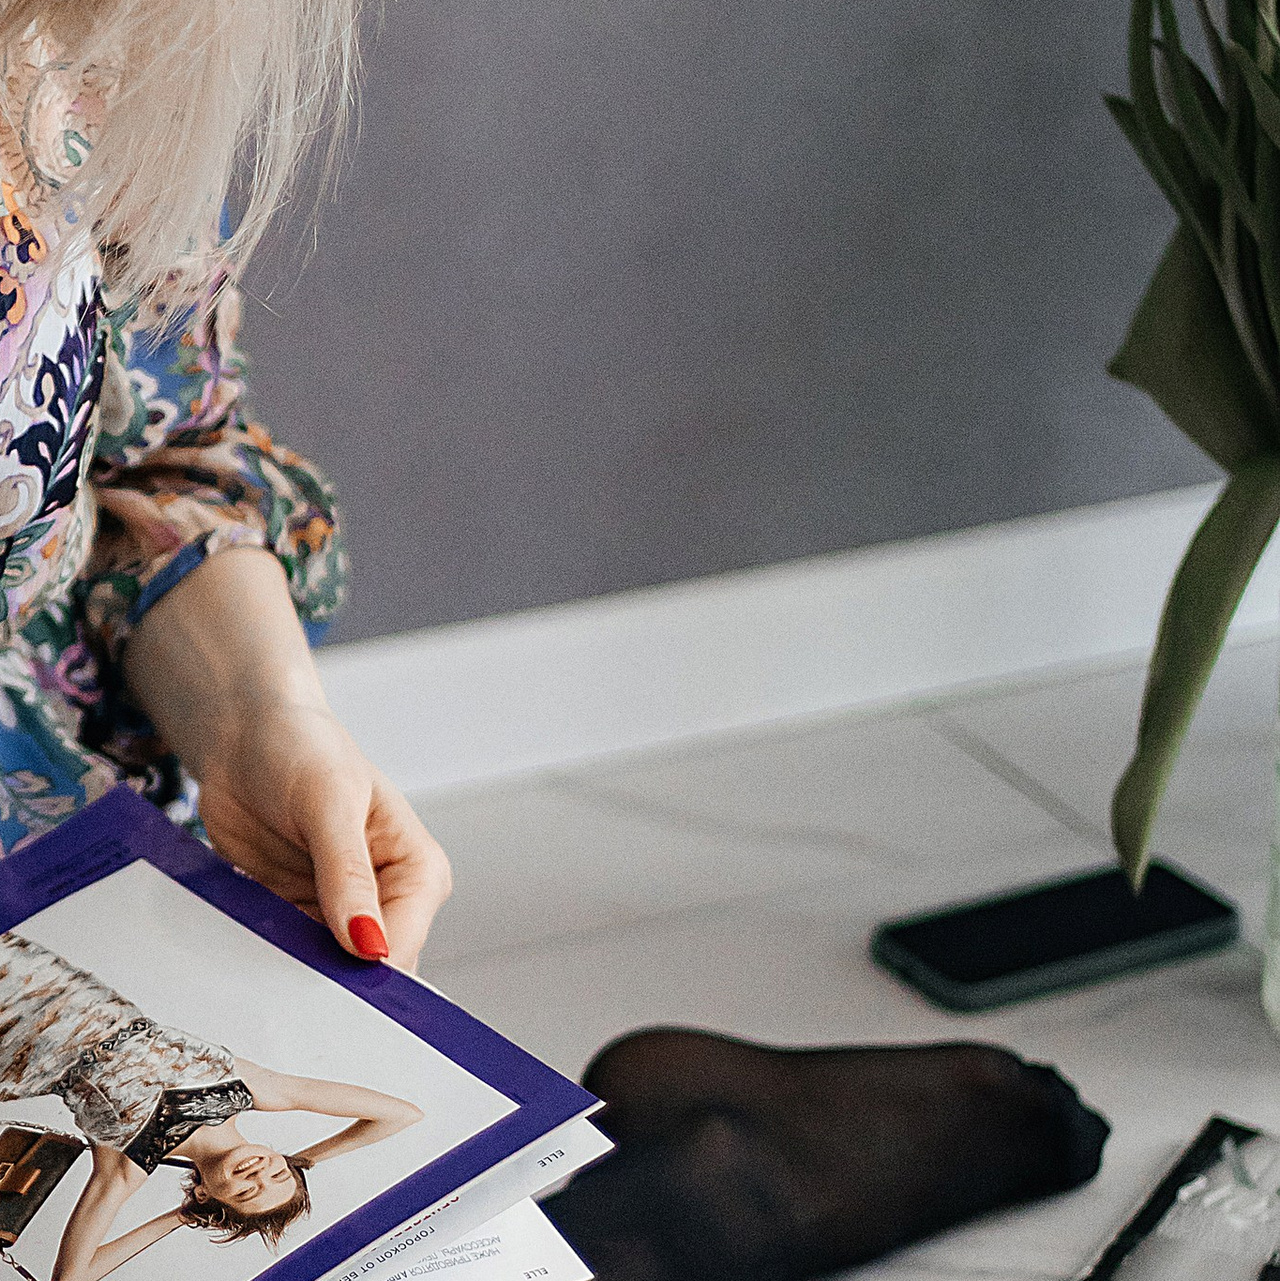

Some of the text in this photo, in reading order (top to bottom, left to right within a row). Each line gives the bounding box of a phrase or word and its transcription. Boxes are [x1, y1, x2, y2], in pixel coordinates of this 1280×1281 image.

[537, 1149, 565, 1168] ELLE
[376, 1225, 435, 1263] ГОРОСКОП
[472, 1248, 500, 1261] НИЖЕ
[360, 1261, 375, 1274] ОТ
[409, 1254, 472, 1277] ПРИВОДЯТСЯ
[523, 1267, 549, 1280] ELLE
